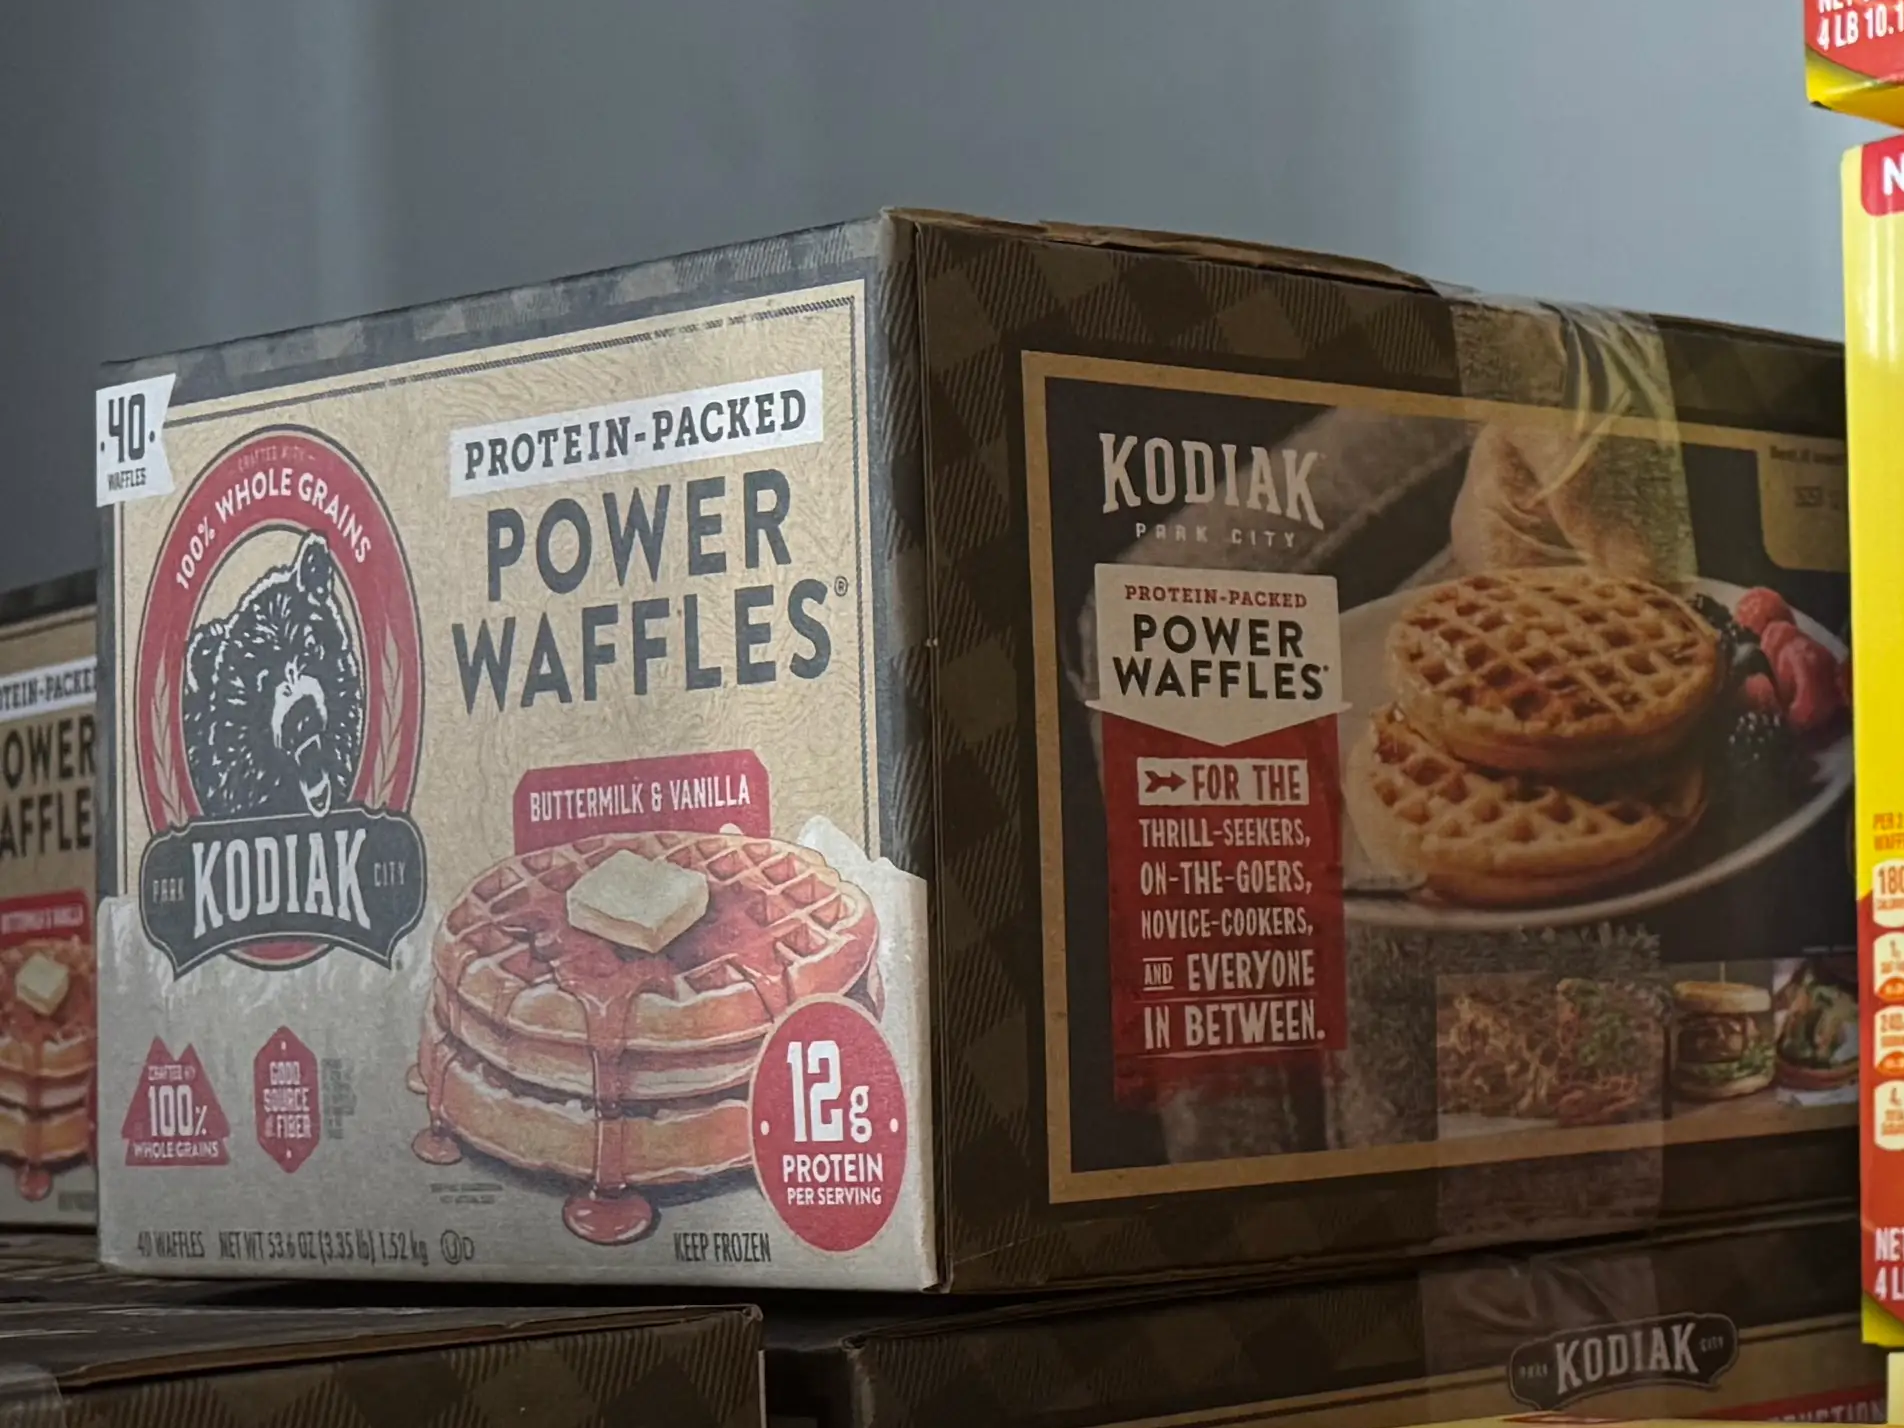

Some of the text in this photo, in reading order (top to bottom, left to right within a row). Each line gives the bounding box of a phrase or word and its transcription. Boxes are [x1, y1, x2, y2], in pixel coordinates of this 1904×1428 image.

[108, 393, 146, 463] 40
[465, 388, 807, 480] PROTEIN-PACKED
[107, 467, 146, 491] WAFFLES
[1099, 433, 1324, 531] KODIAK
[176, 468, 371, 590] 100% WHOLE GRAINS
[487, 468, 793, 602] POWER
[1231, 529, 1297, 548] CITY
[1124, 584, 1308, 608] PROTEIN-PACKED
[1133, 613, 1304, 658] POWER
[2, 715, 96, 789] OWER
[530, 783, 644, 823] BUTTERMILK
[670, 774, 751, 809] VANILLA
[1192, 763, 1301, 801] FOR THE
[1138, 818, 1311, 848] THRILL-SEEKERS,
[192, 828, 371, 939] KODIAK
[1140, 860, 1313, 895] ON-THE-GOERS,
[1141, 906, 1314, 939] NOVICE-COOKERS,
[1144, 949, 1315, 992] AND EVERYONE
[1144, 998, 1326, 1050] IN BETWEEN.
[148, 1085, 208, 1137] 100%
[787, 1040, 873, 1143] 12g
[134, 1140, 219, 1158] WHOLE GRAINS
[782, 1153, 884, 1183] PROTEIN
[787, 1188, 882, 1206] PER SERVING
[673, 1233, 772, 1262] KEEP FROZEN
[1555, 1322, 1700, 1396] KODIAK
